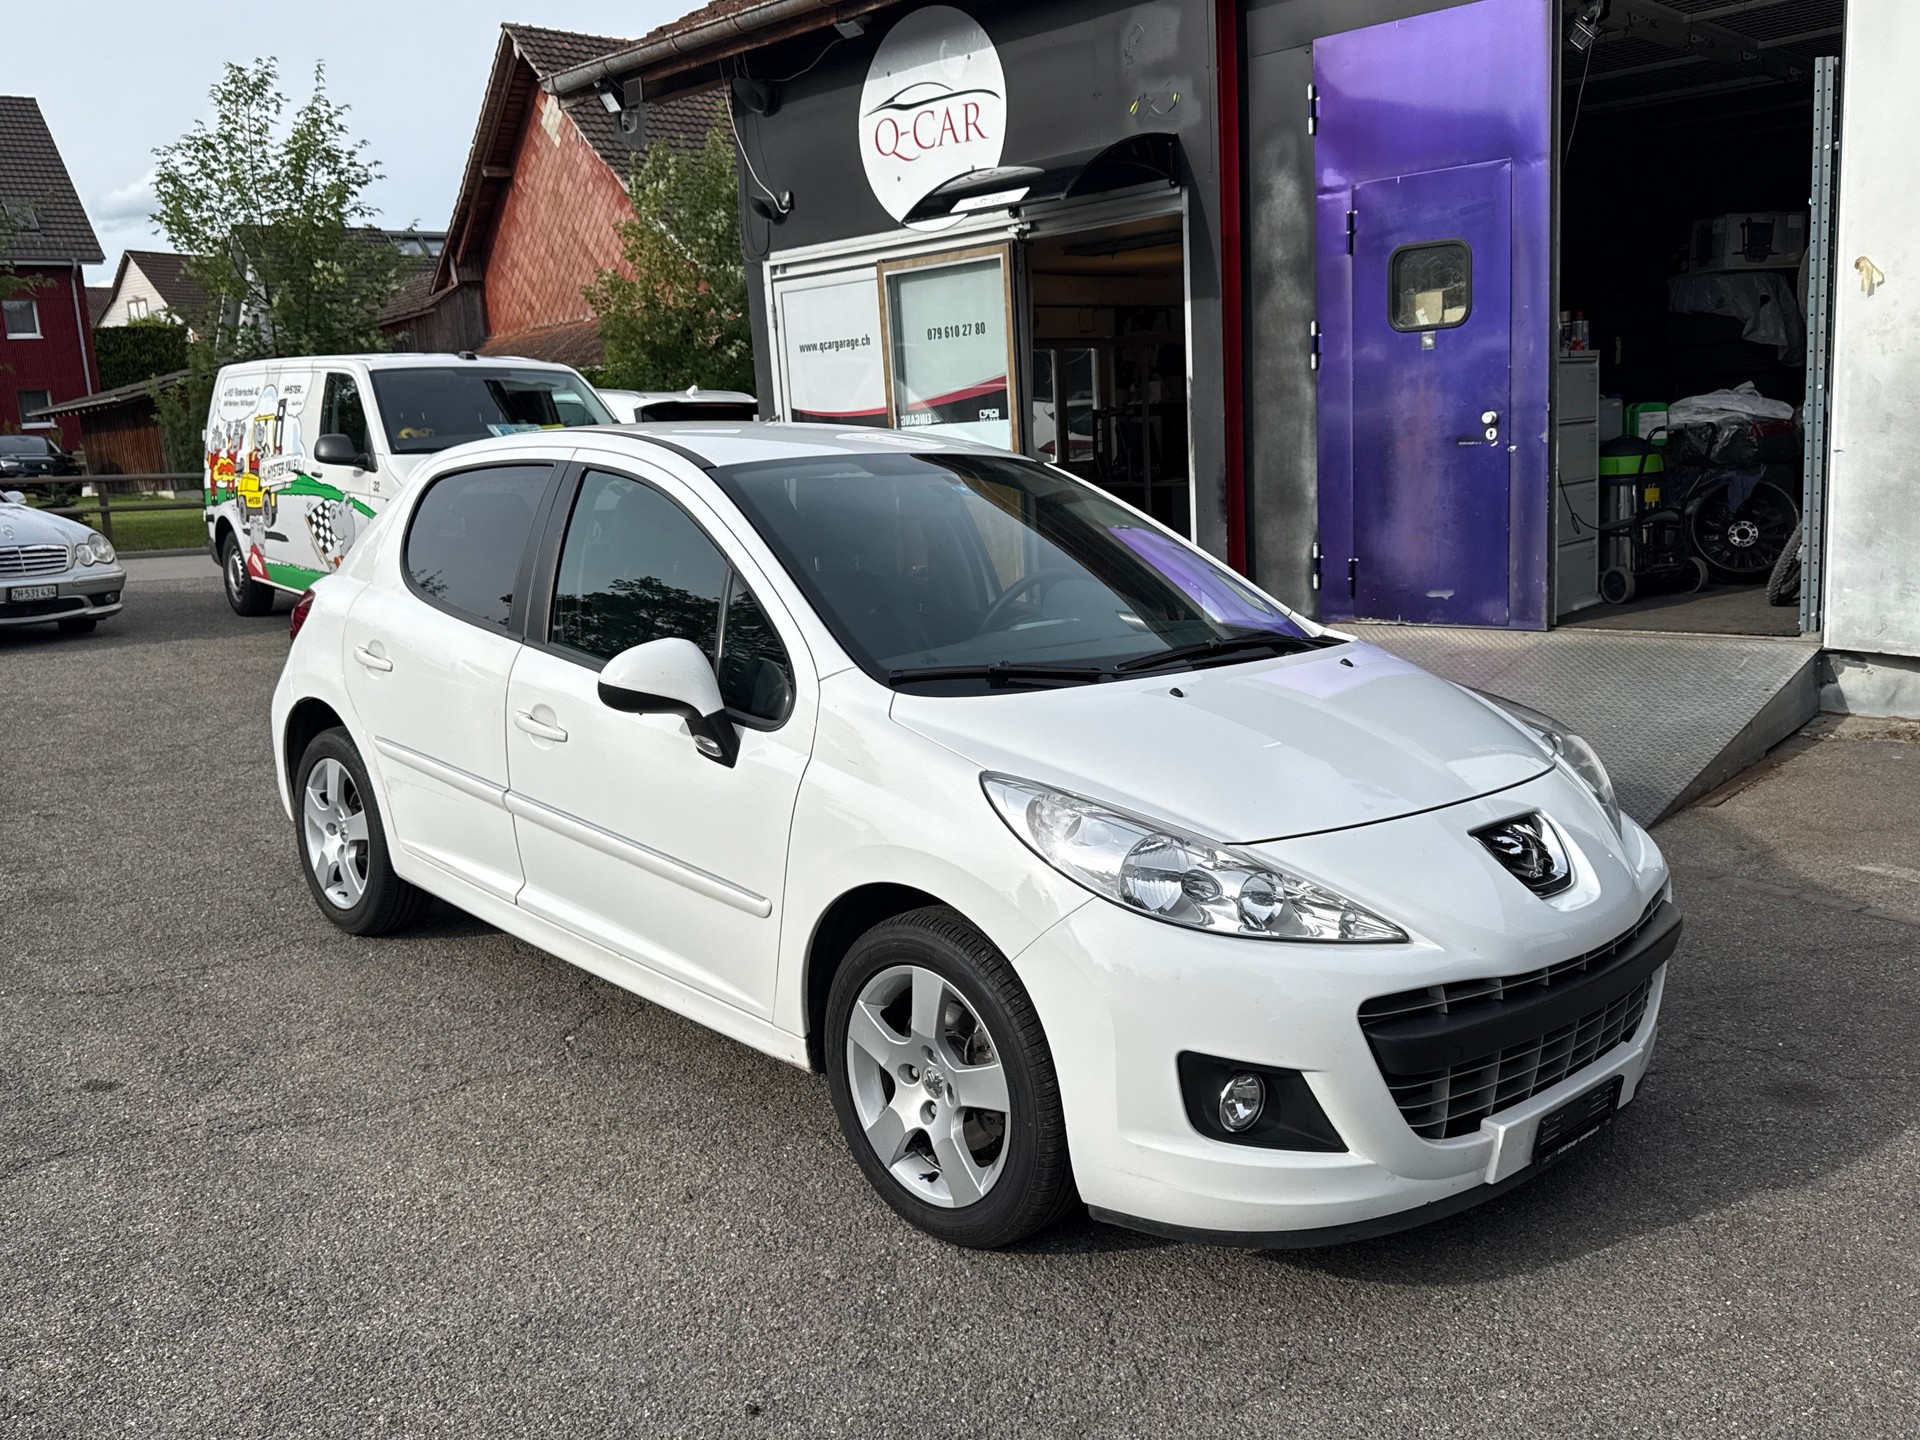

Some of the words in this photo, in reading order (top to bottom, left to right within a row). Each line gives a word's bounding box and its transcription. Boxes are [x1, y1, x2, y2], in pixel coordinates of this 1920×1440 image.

[875, 102, 989, 161] Q-CAR
[927, 327, 943, 341] 079
[944, 325, 960, 339] 610
[962, 323, 972, 337] 27
[975, 321, 986, 335] 80
[799, 333, 871, 353] www.qcargarage.ch
